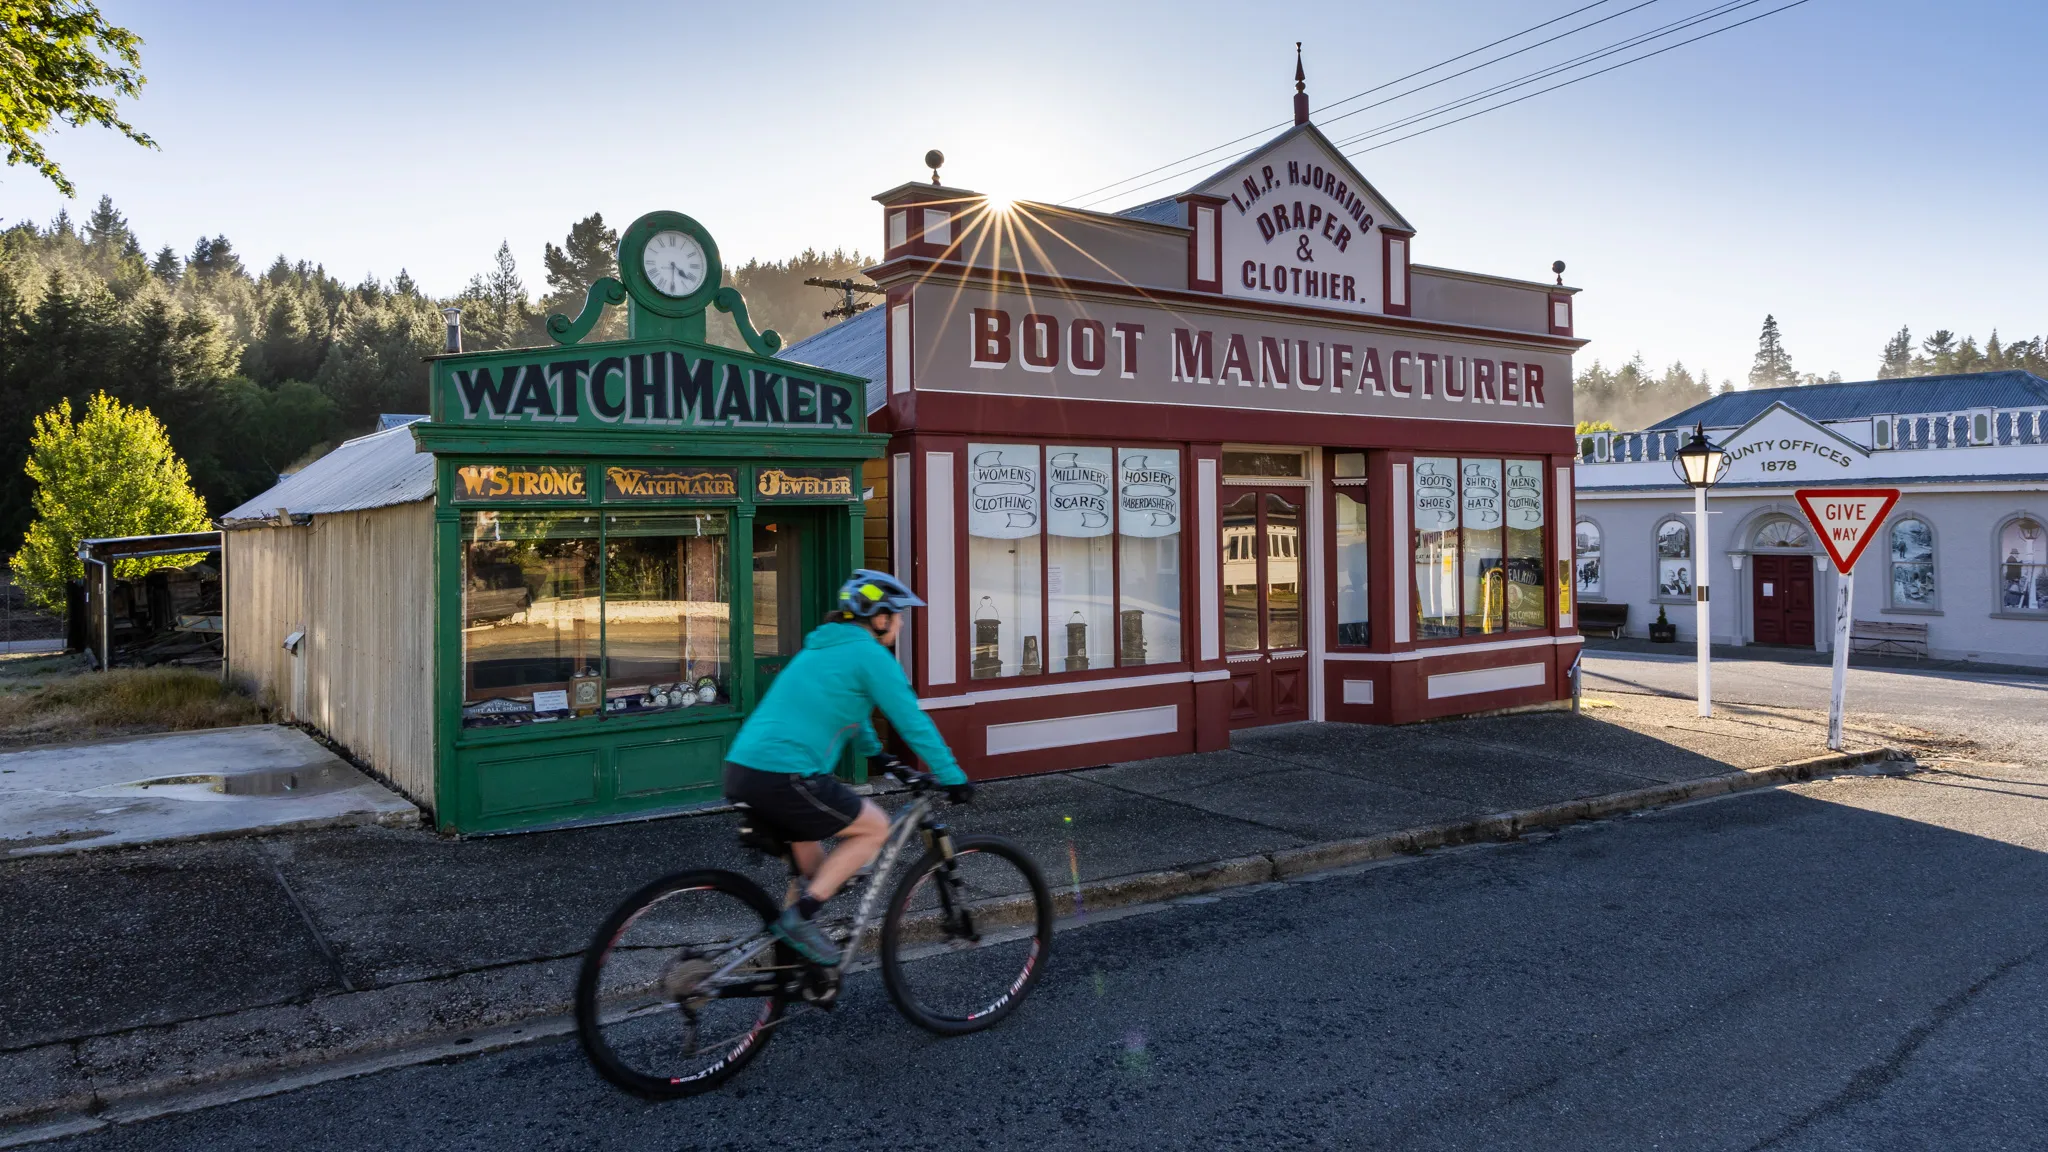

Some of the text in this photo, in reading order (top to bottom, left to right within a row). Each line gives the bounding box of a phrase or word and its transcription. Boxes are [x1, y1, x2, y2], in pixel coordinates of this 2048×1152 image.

[1288, 161, 1374, 234] HJORRING
[1256, 201, 1351, 253] DRAPER
[1297, 234, 1314, 262] &
[970, 308, 1546, 409] BOOT MANUFACTURER
[452, 351, 854, 430] WATCHMAKER
[1779, 439, 1852, 468] OFFICES
[1761, 460, 1797, 472] 1878
[979, 468, 1031, 482] WOMENS
[1052, 469, 1108, 485] MILLINERY
[1125, 471, 1174, 486] HOSIERY
[1420, 476, 1452, 487] BOOTS
[1466, 477, 1497, 488] SHIRTS
[1511, 477, 1536, 488] MENS
[612, 472, 736, 496] WATCHMAKER
[758, 471, 852, 496] JEWELLER
[975, 496, 1032, 511] CLOTHING
[1054, 496, 1105, 511] SCARFS
[1122, 496, 1174, 512] HABERDASHERY
[1420, 498, 1451, 508] SHOES
[1468, 498, 1494, 508] HATS
[1508, 498, 1540, 509] CLOTHING
[1826, 504, 1866, 520] GIVE
[1833, 528, 1858, 541] WAY
[1508, 568, 1537, 585] EALAND
